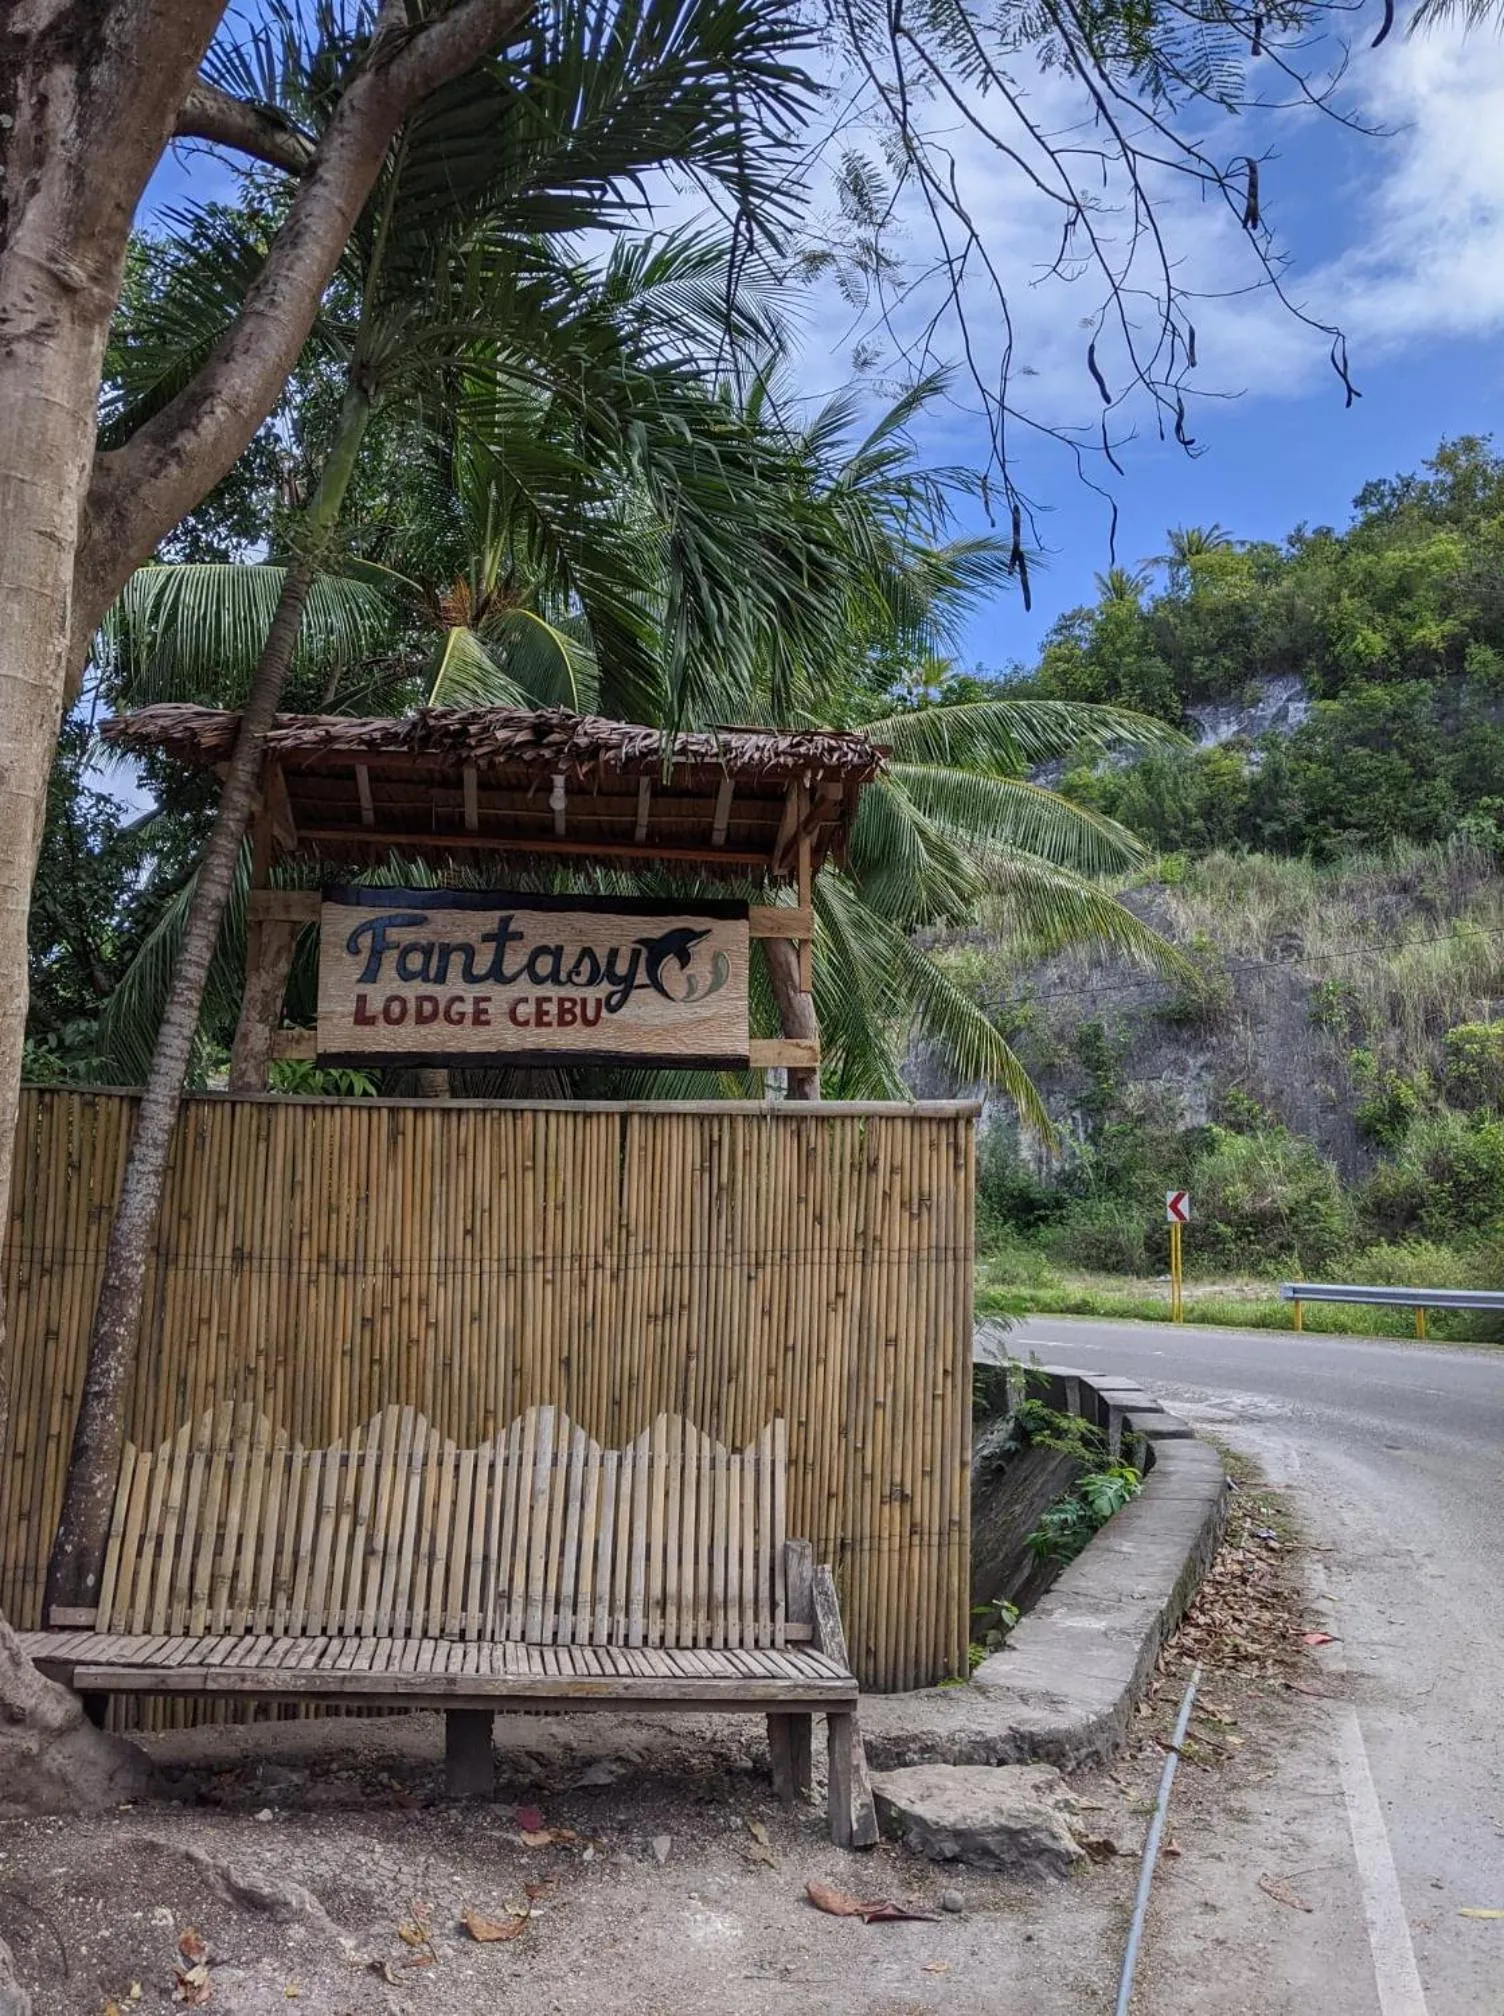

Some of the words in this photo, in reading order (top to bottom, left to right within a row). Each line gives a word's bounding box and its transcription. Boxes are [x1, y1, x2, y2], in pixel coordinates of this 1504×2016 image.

[347, 912, 645, 1014] Fantasy
[353, 993, 491, 1026] LODGE
[508, 996, 602, 1028] CEBU
